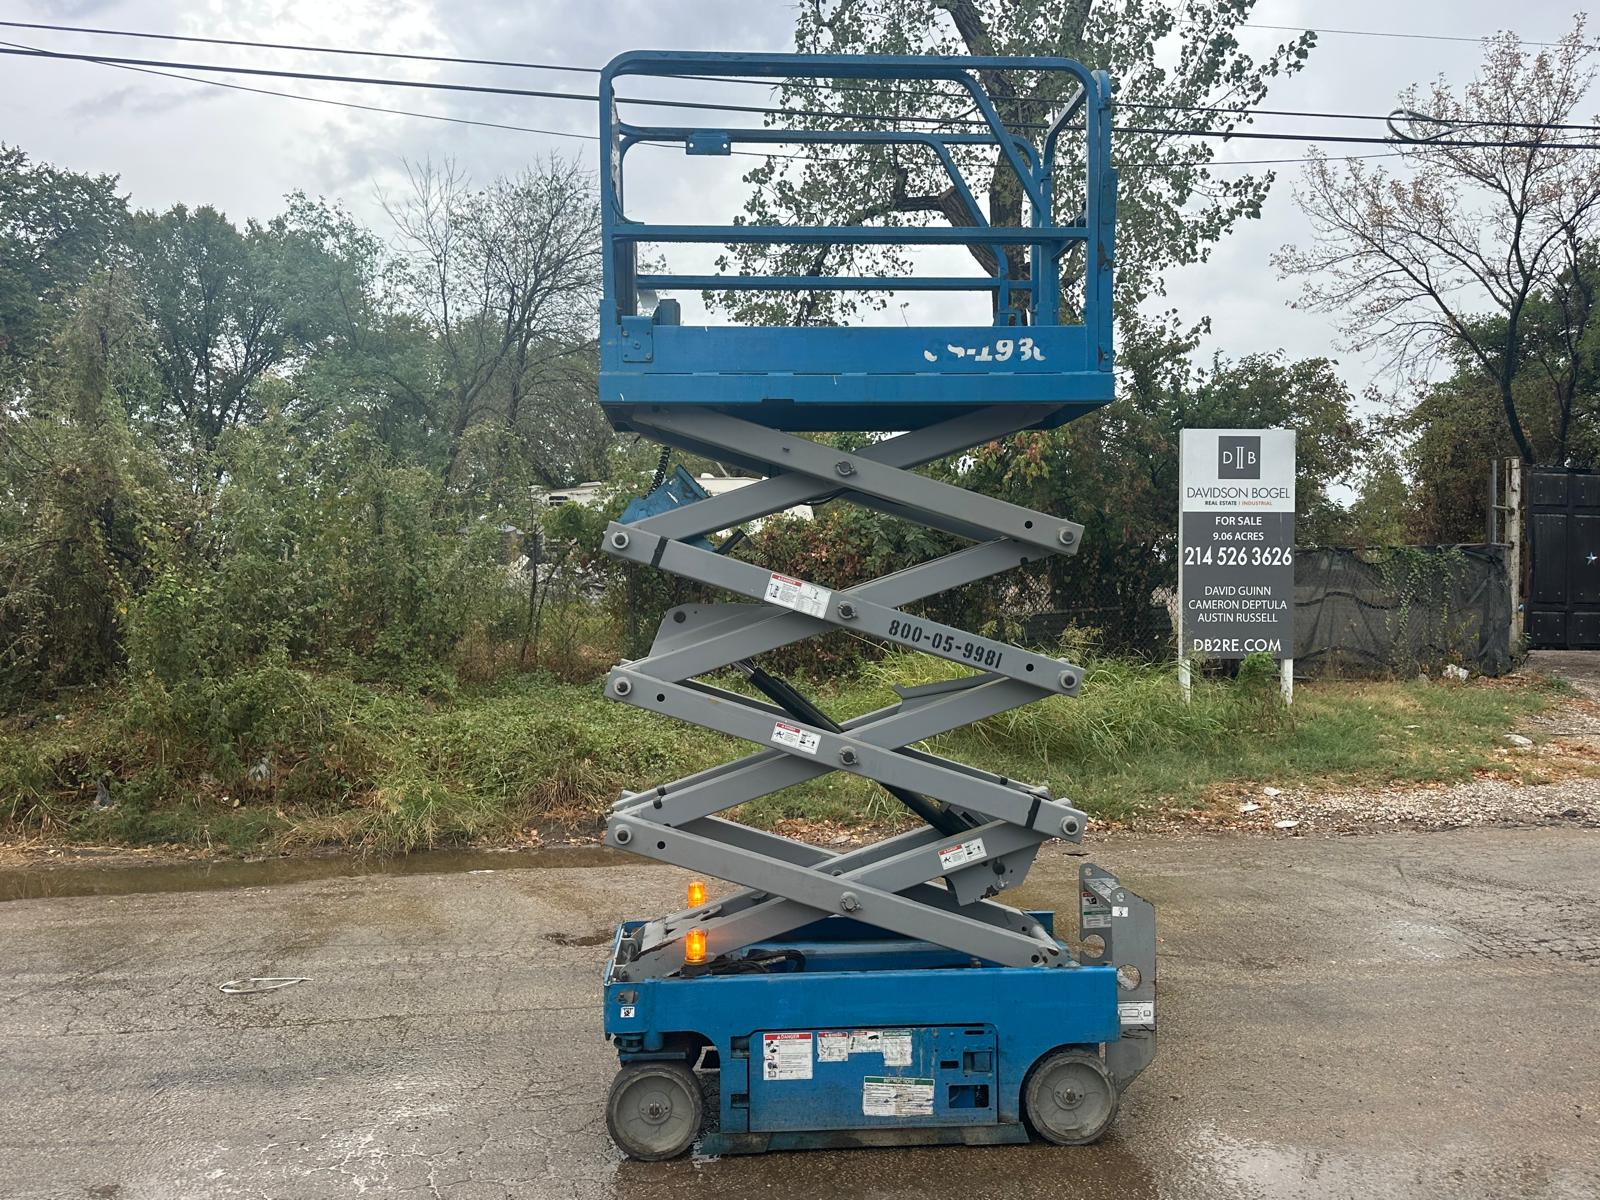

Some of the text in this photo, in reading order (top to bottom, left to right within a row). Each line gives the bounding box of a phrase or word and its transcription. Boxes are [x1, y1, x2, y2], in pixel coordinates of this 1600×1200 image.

[1187, 487, 1290, 499] DAVIDSON BOGEL
[1215, 516, 1263, 526] FOR SALE
[1212, 532, 1264, 541] 9.06 ACRES
[1184, 546, 1293, 566] 214 526 3626
[1204, 586, 1272, 596] DAVID GUINN
[1188, 600, 1288, 610] CAMERON DEPTULA
[1197, 612, 1279, 623] AUSTIN RUSSELL
[888, 619, 1003, 669] 800-05-9981
[1193, 638, 1282, 652] DB2RE.COM
